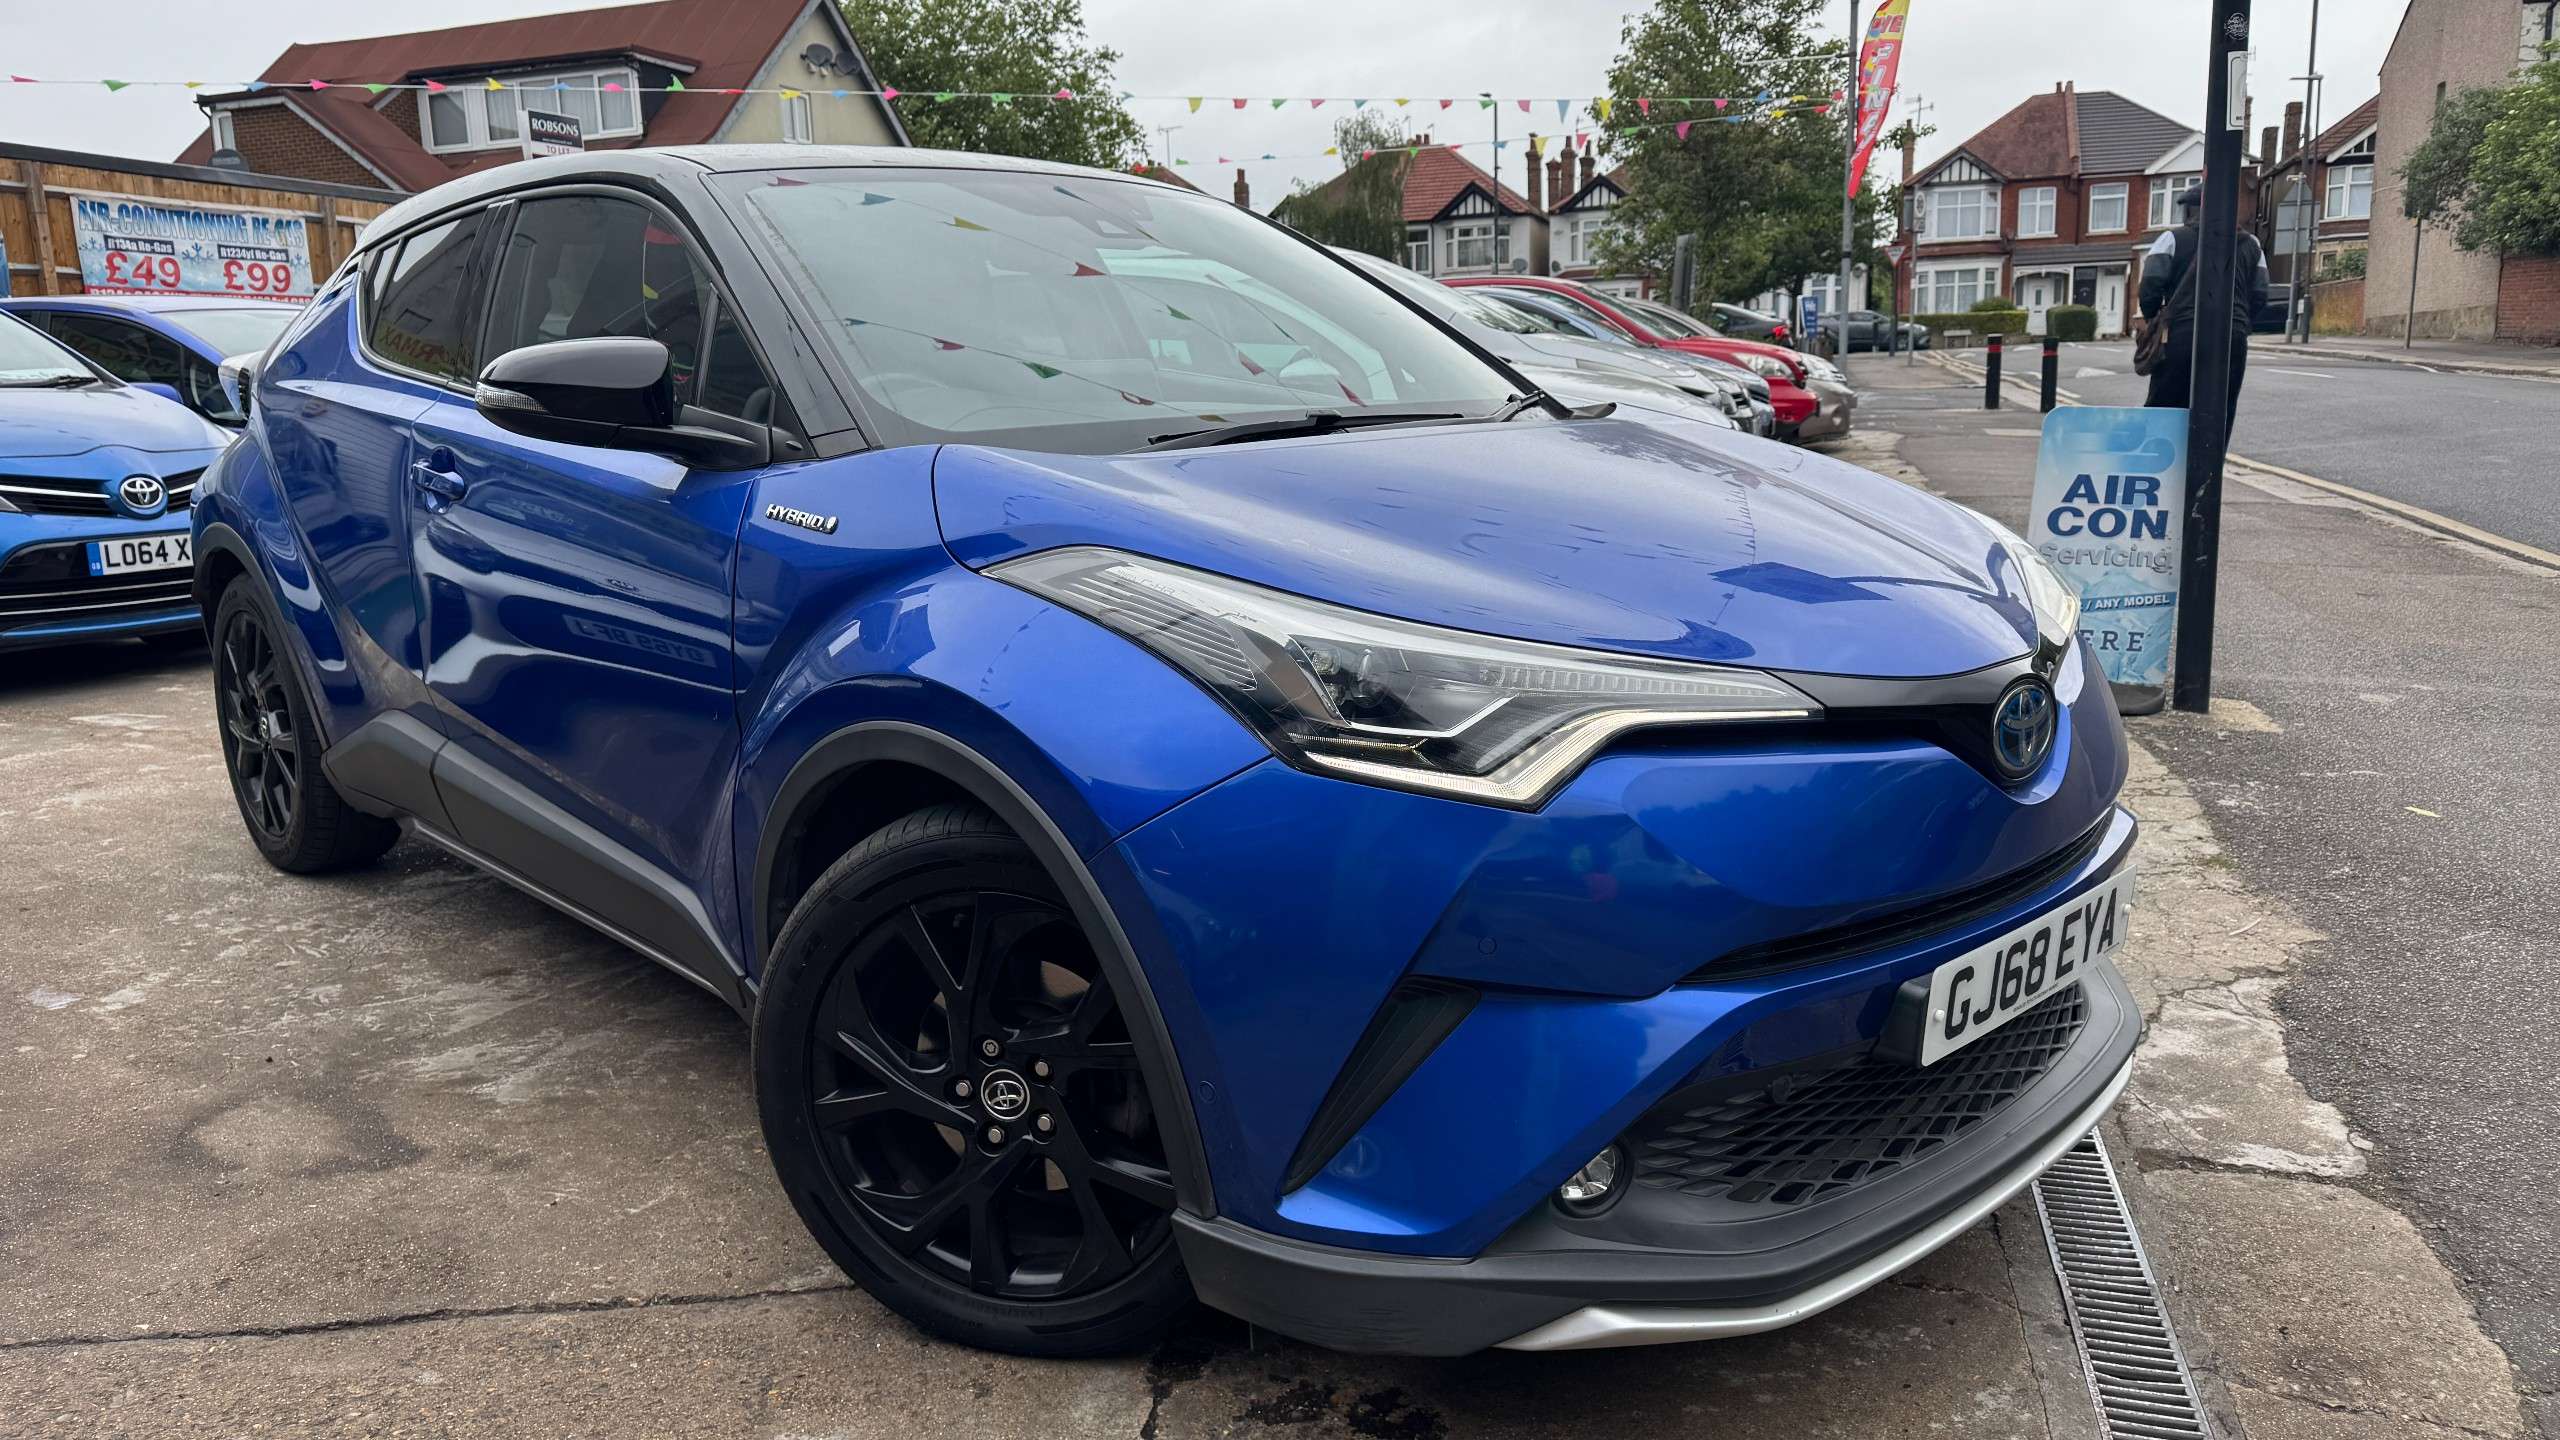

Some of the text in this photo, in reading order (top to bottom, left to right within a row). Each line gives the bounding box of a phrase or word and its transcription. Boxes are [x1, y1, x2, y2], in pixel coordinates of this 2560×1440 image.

[531, 118, 579, 136] ROBSONS
[107, 238, 138, 250] R134a
[105, 251, 181, 288] £49
[223, 260, 292, 293] £99
[2061, 474, 2161, 506] AIR
[765, 503, 825, 529] HYBRID
[2047, 506, 2169, 540] CON
[2039, 542, 2171, 574] Servicing
[2094, 598, 2121, 609] ANY
[2123, 594, 2170, 607] MODEL
[2080, 629, 2145, 651] ERE
[1944, 887, 2118, 1041] GJ68 EYA
